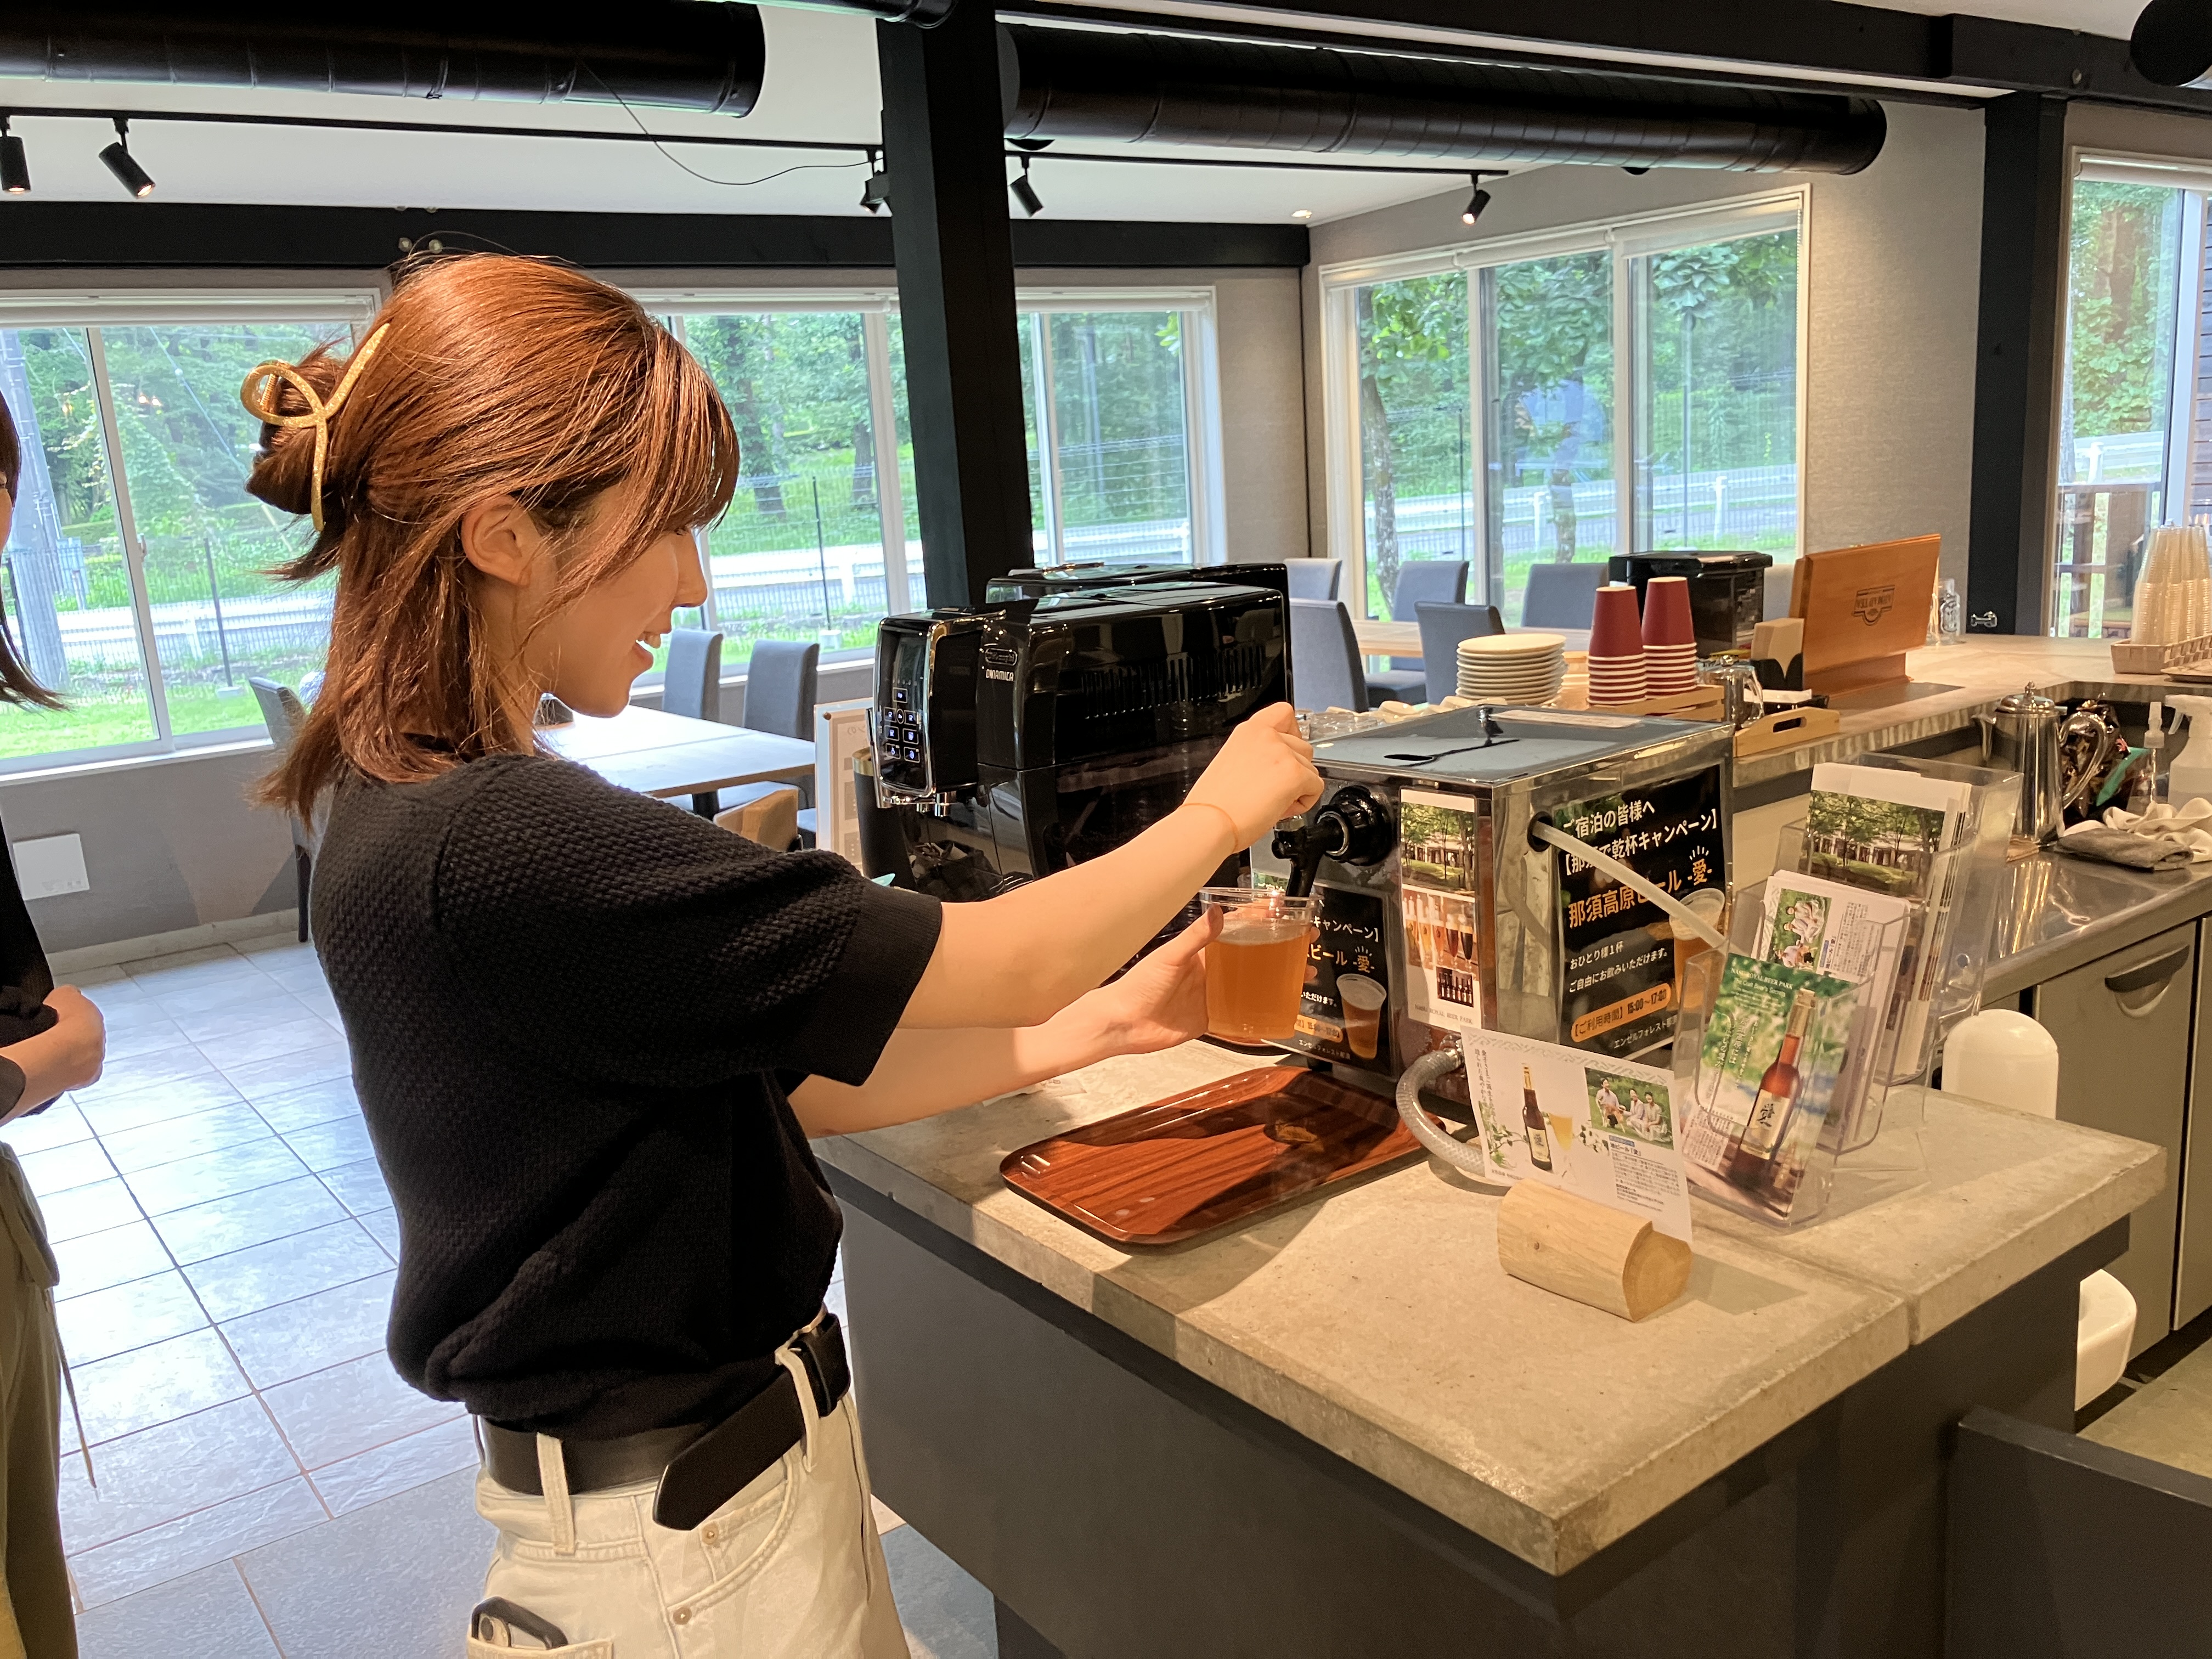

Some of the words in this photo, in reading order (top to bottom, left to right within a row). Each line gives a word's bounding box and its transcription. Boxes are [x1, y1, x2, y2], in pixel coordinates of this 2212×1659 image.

[985, 669, 1014, 681] DINAMICA
[1691, 858, 1708, 886] 愛
[1568, 947, 1668, 993] ご自由にお飲みいただけます。
[1569, 940, 1624, 970] おひとり様1杯
[1575, 1006, 1623, 1037] 【ご利用時間】
